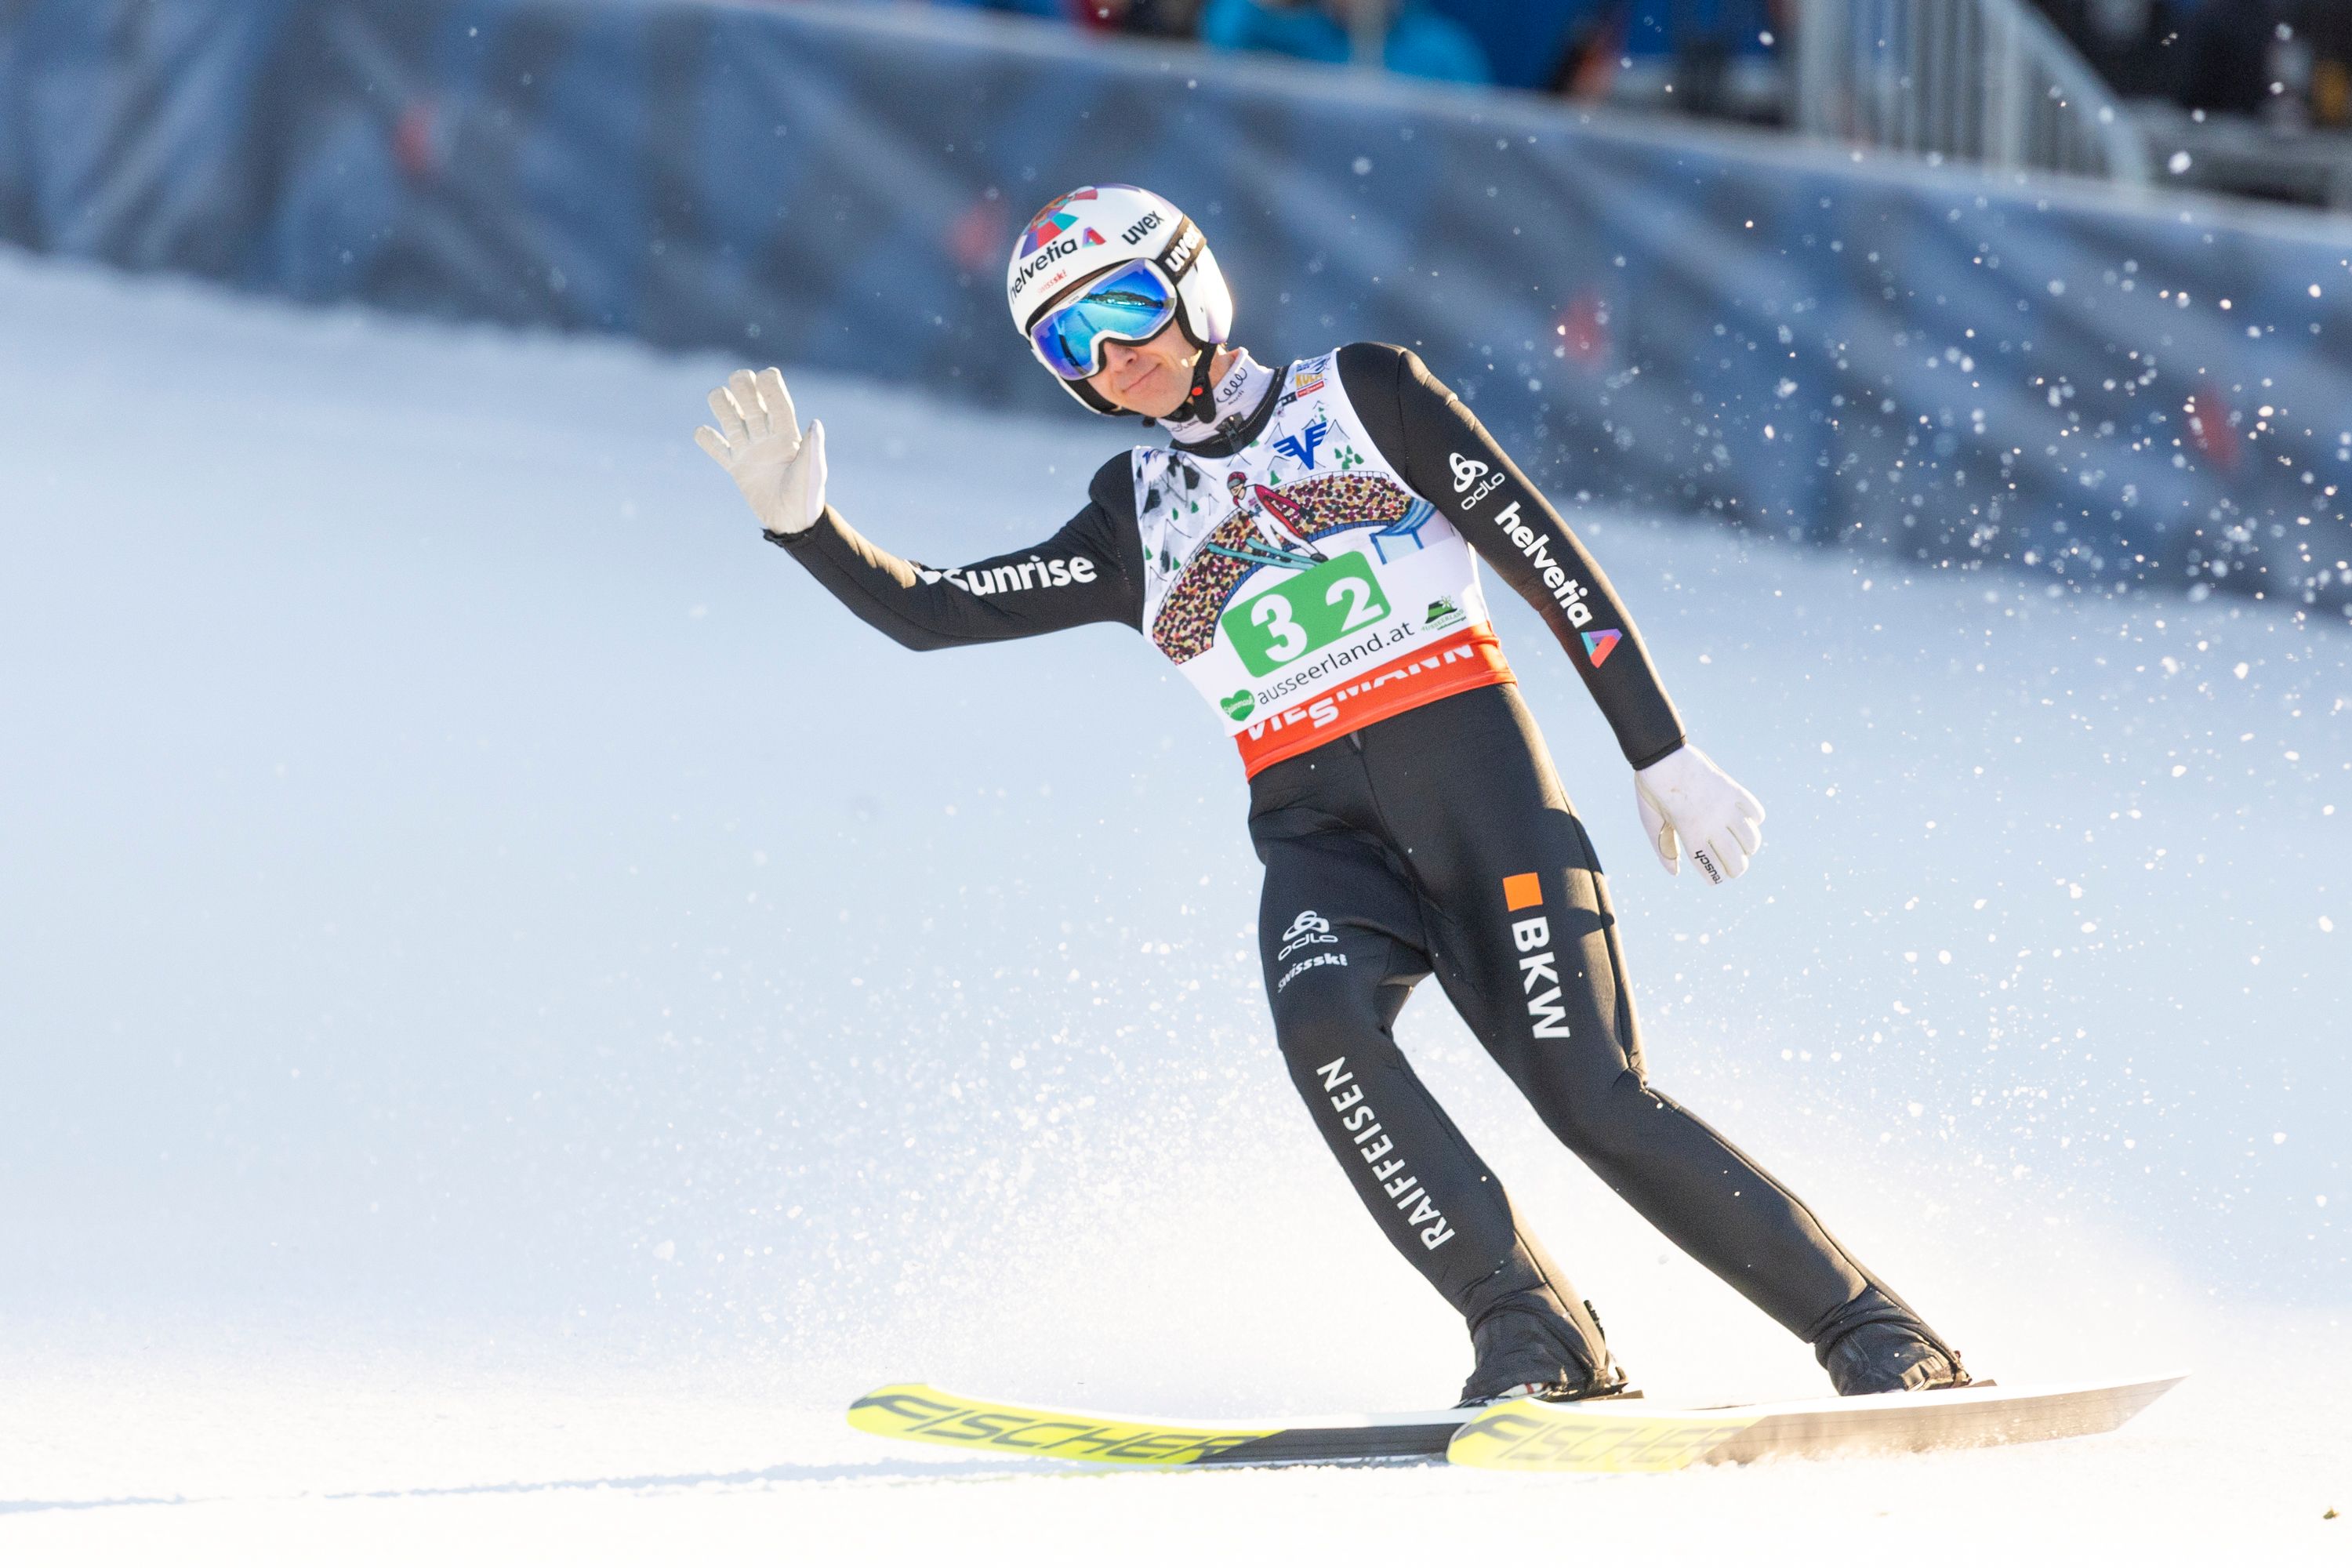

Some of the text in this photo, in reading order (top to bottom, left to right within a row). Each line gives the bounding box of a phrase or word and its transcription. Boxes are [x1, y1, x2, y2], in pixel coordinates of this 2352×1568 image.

[1121, 210, 1165, 245] uvex
[1009, 238, 1079, 304] helvetia
[1494, 500, 1593, 629] helvetia
[1251, 576, 1384, 662] 3 2
[1258, 622, 1415, 705] ausseerland.at
[1694, 850, 1722, 884] reusch
[1512, 916, 1570, 1040] BKW
[1316, 1056, 1455, 1250] RAIFFEISEN
[851, 1395, 1261, 1460] FISCHER
[1452, 1414, 1747, 1463] FISCHER
